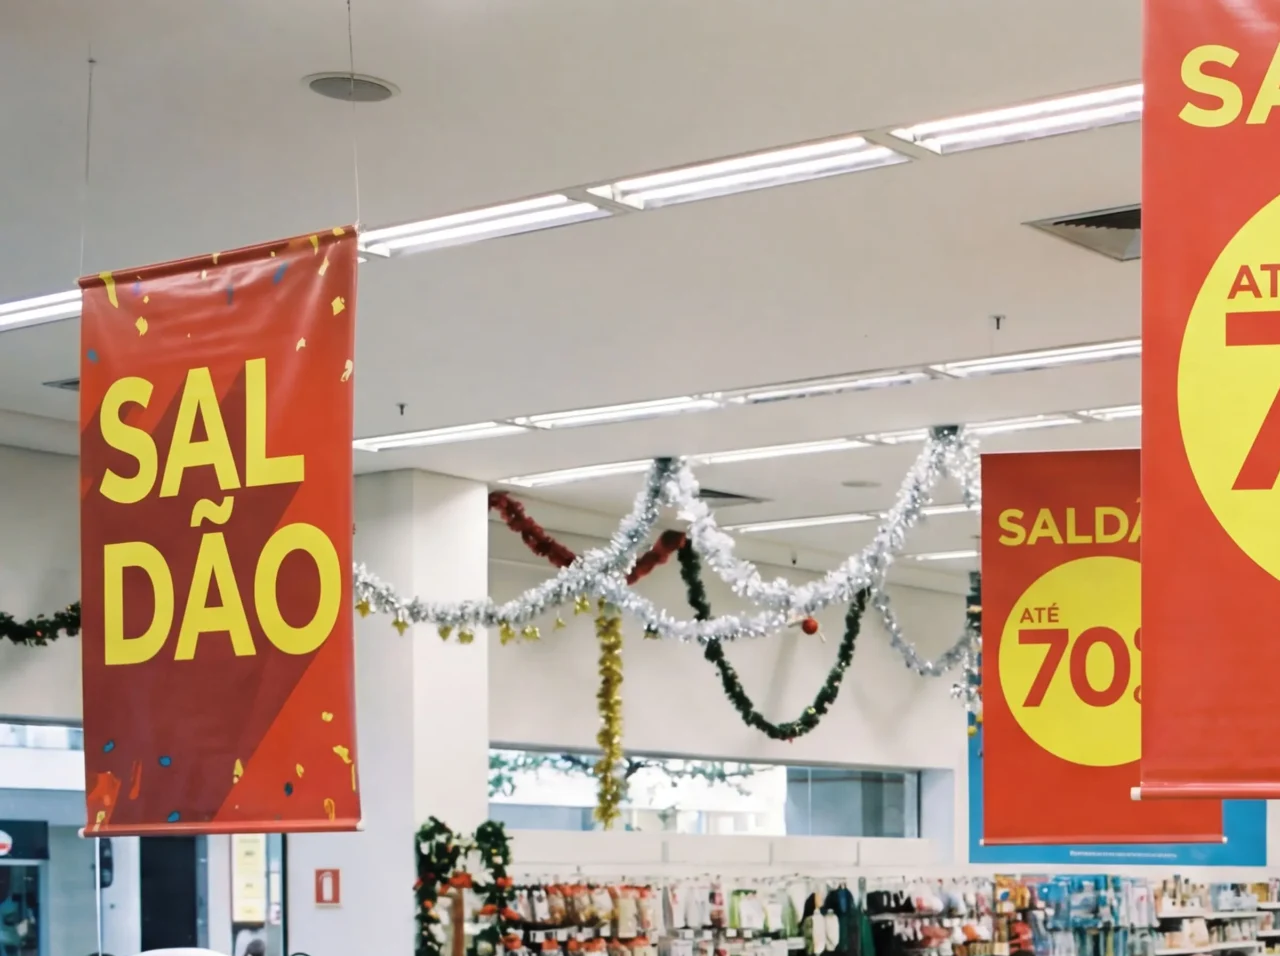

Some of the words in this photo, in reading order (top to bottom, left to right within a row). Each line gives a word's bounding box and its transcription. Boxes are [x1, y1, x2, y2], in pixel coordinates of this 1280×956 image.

[99, 358, 304, 503] SAL
[998, 497, 1141, 546] SALD
[104, 496, 341, 665] DÃO
[1020, 603, 1059, 624] ATÉ
[1018, 626, 1141, 708] 70
